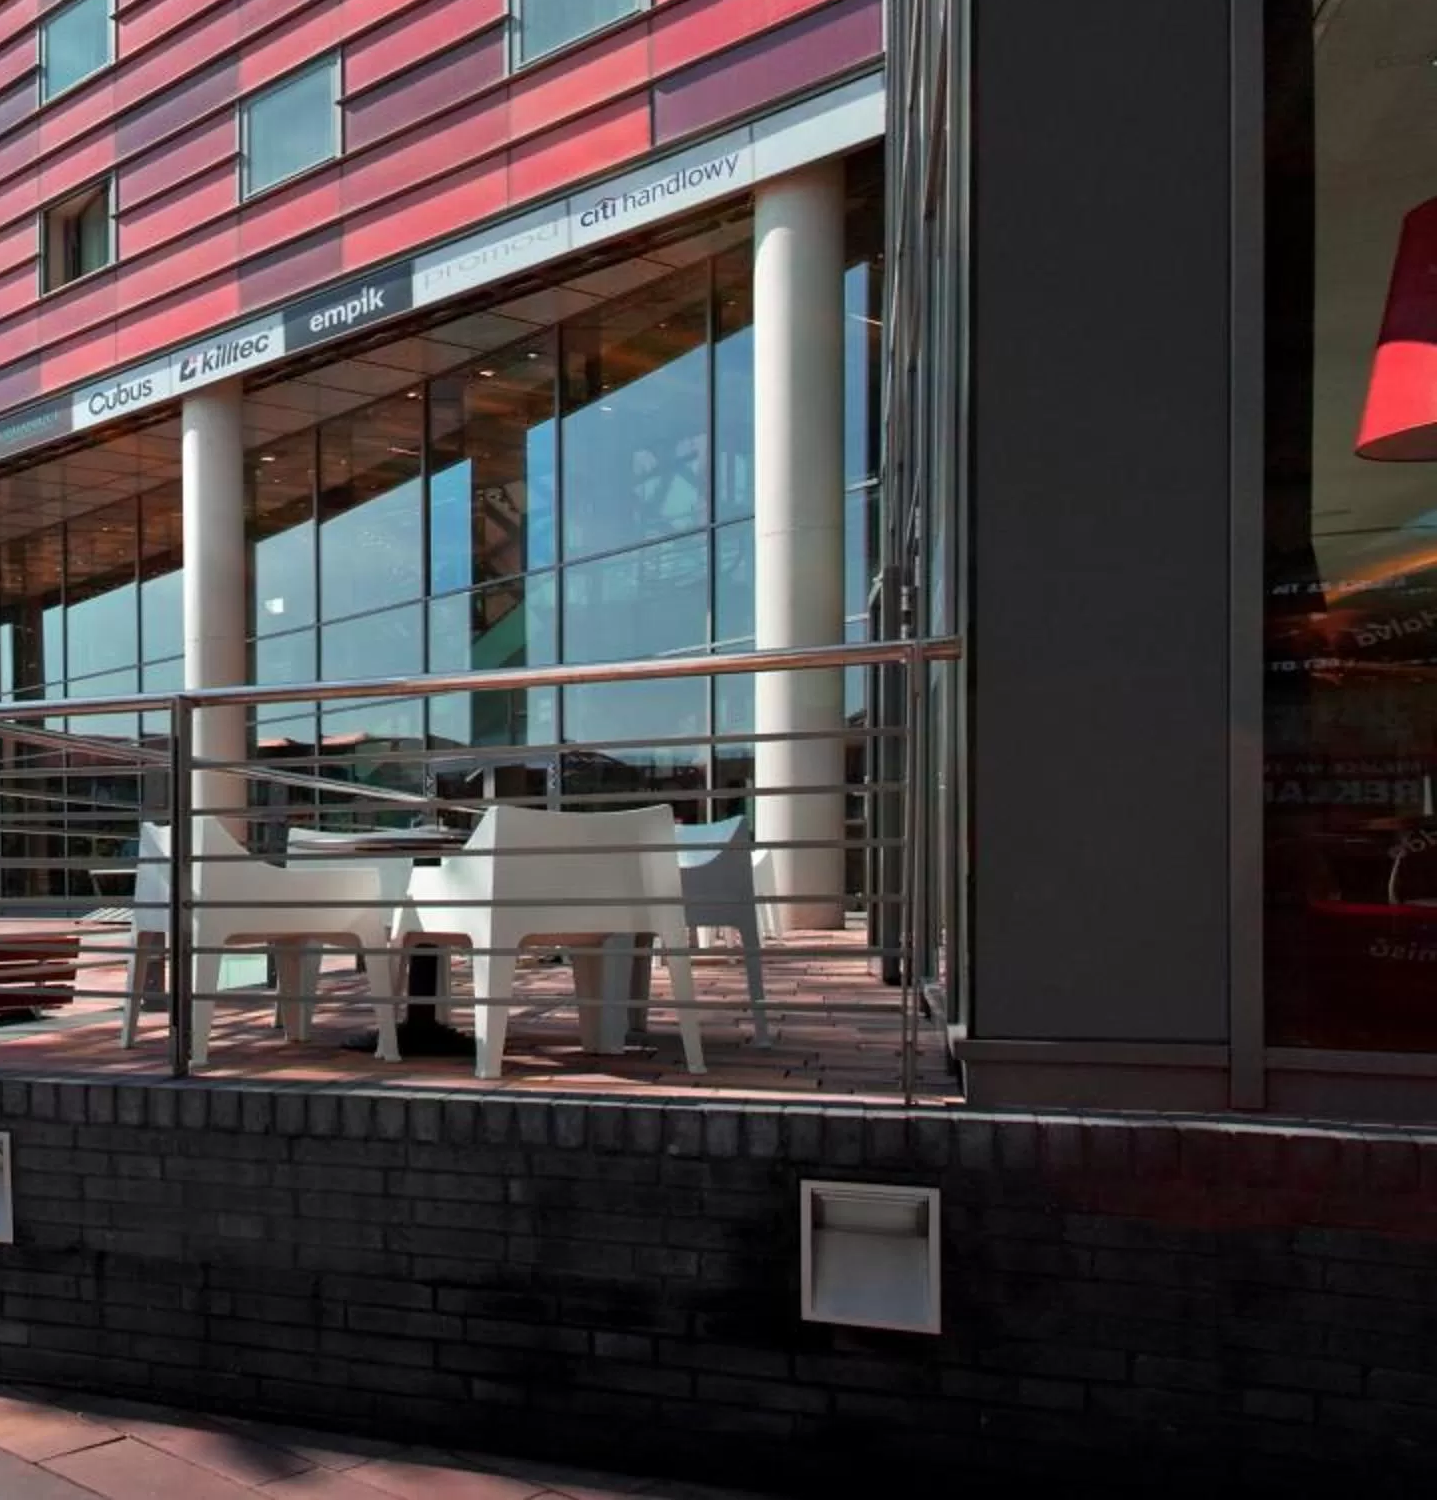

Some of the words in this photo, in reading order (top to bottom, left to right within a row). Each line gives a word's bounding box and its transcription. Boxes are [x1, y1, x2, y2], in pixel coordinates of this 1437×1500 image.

[580, 196, 617, 229] citi
[622, 152, 740, 213] handlowy
[308, 286, 386, 333] empik
[200, 331, 270, 376] killtec
[88, 377, 153, 416] Cubus
